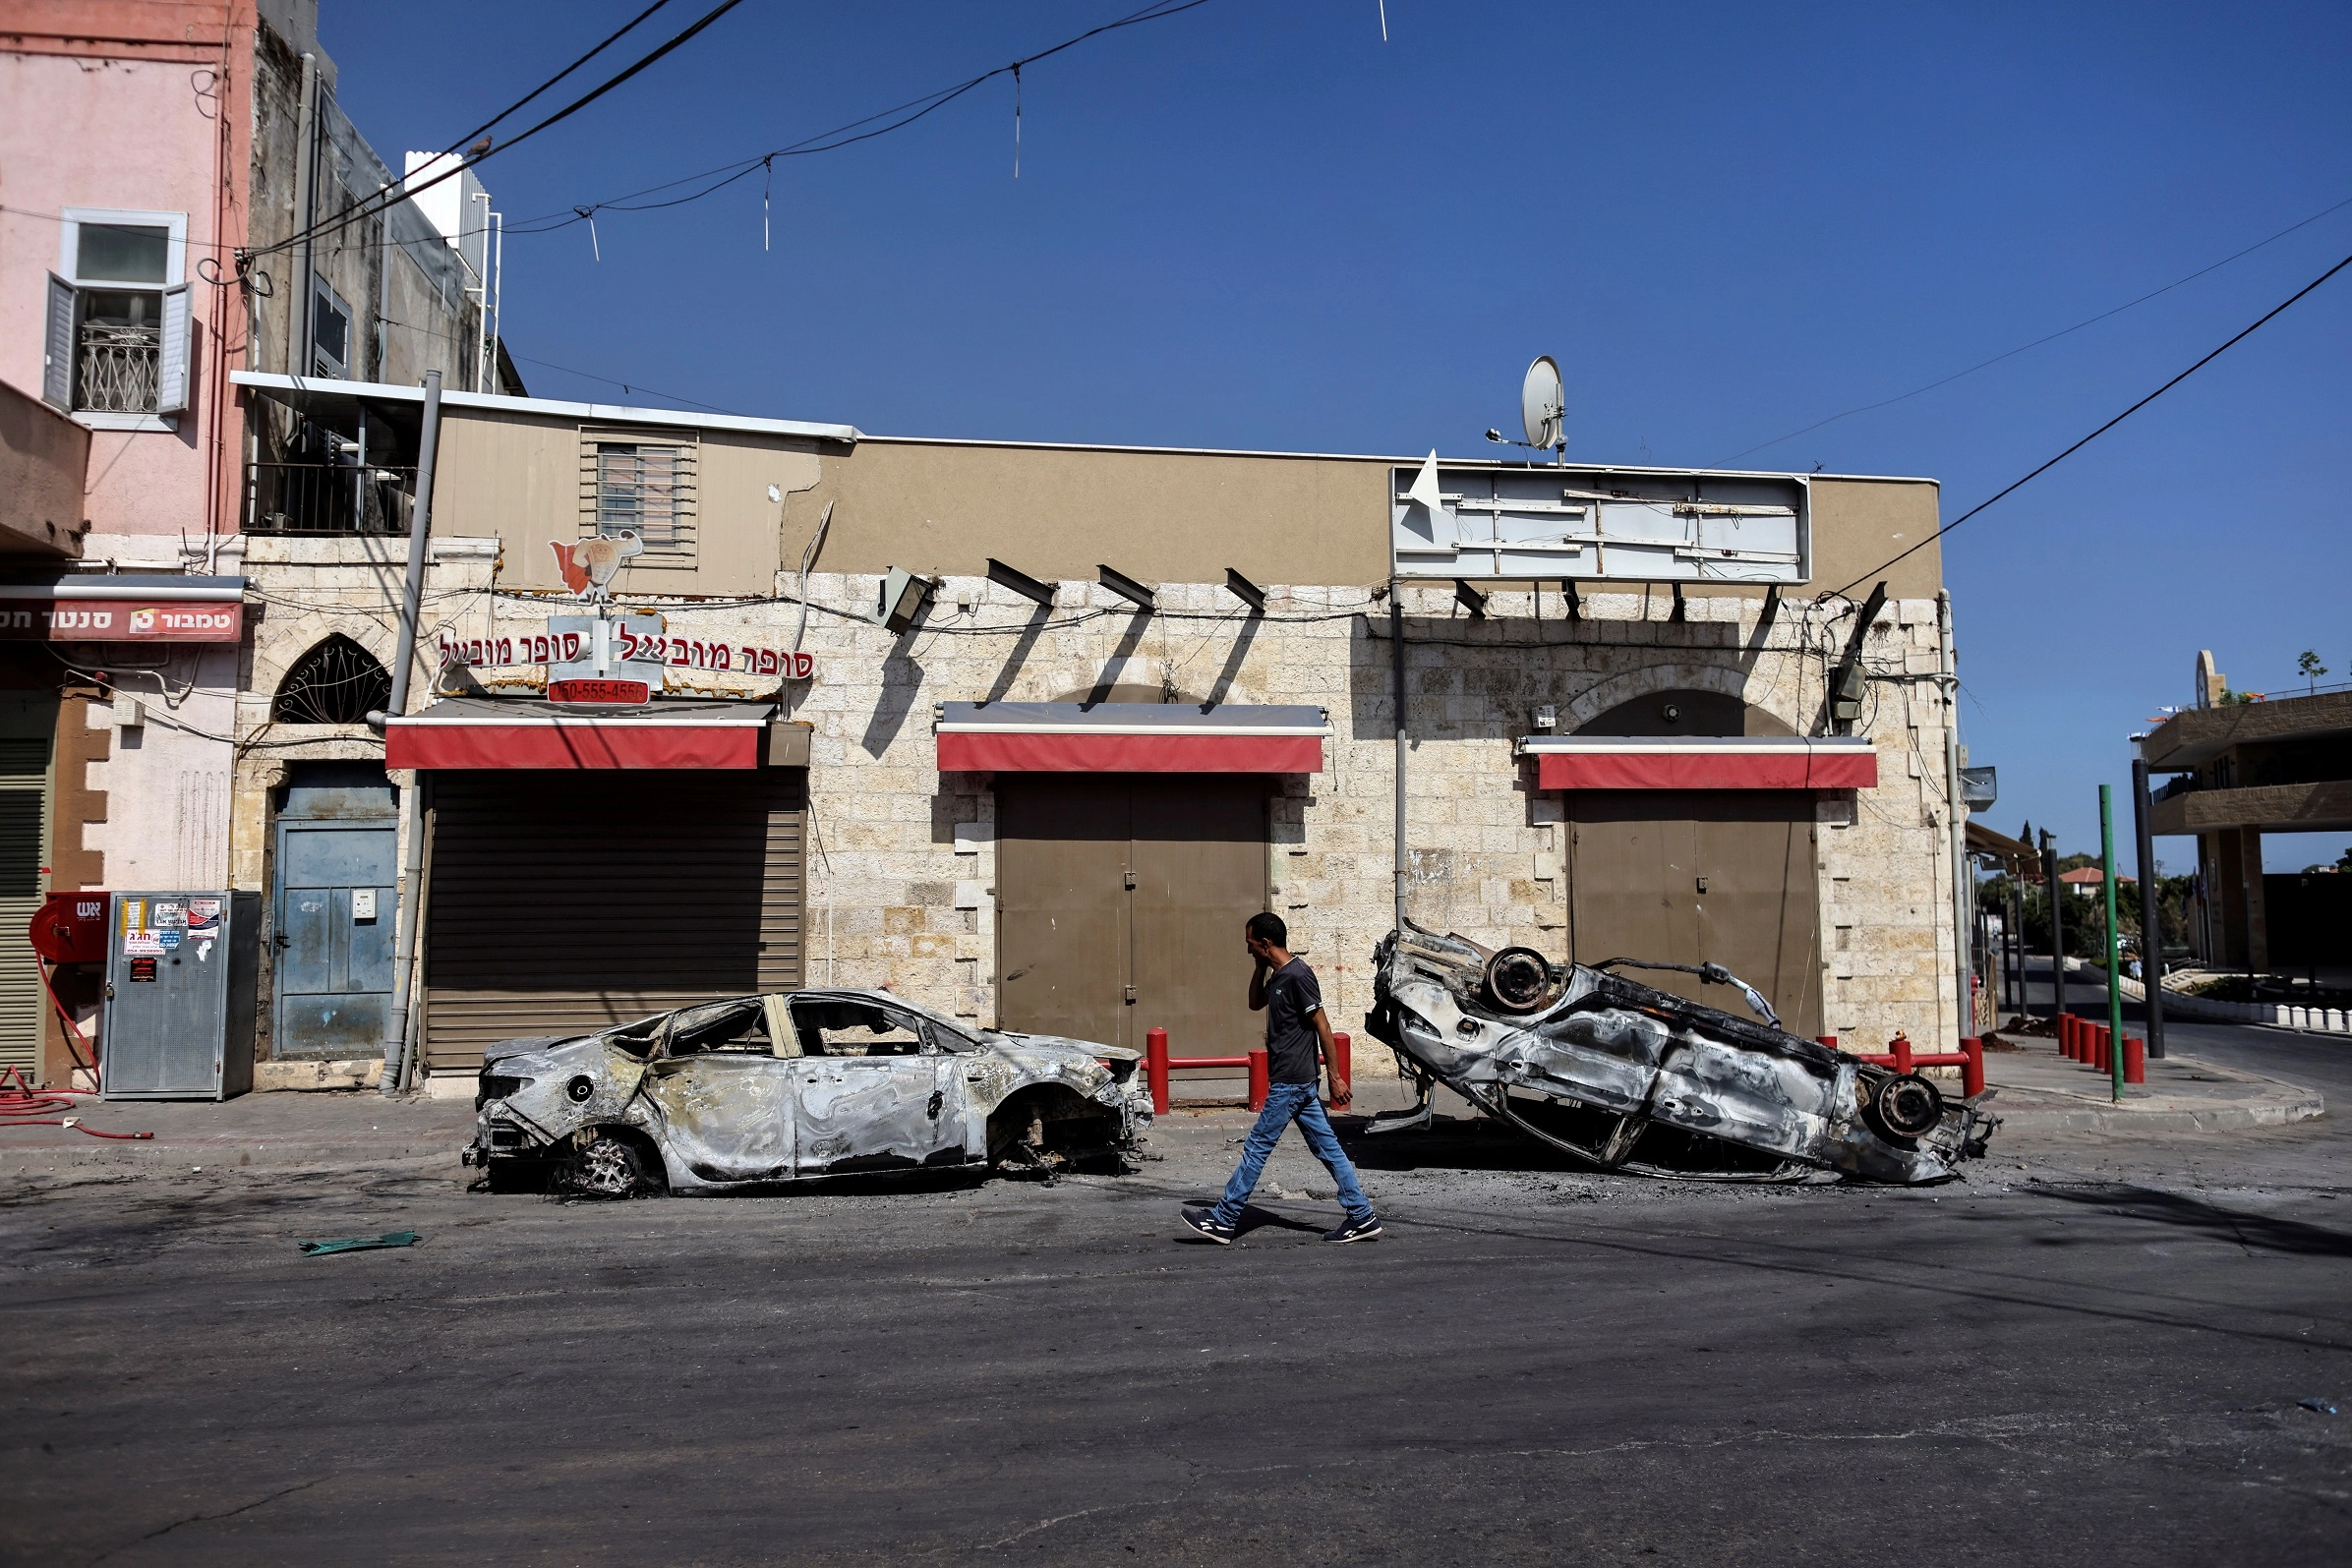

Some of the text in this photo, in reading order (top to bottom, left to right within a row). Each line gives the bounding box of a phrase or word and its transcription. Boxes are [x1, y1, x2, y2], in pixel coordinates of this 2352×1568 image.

[41, 611, 112, 629] סנטר
[160, 613, 231, 629] טמבור
[439, 630, 581, 670] סופר מובייל
[618, 621, 814, 679] סופר מובייל
[77, 901, 101, 917] אש
